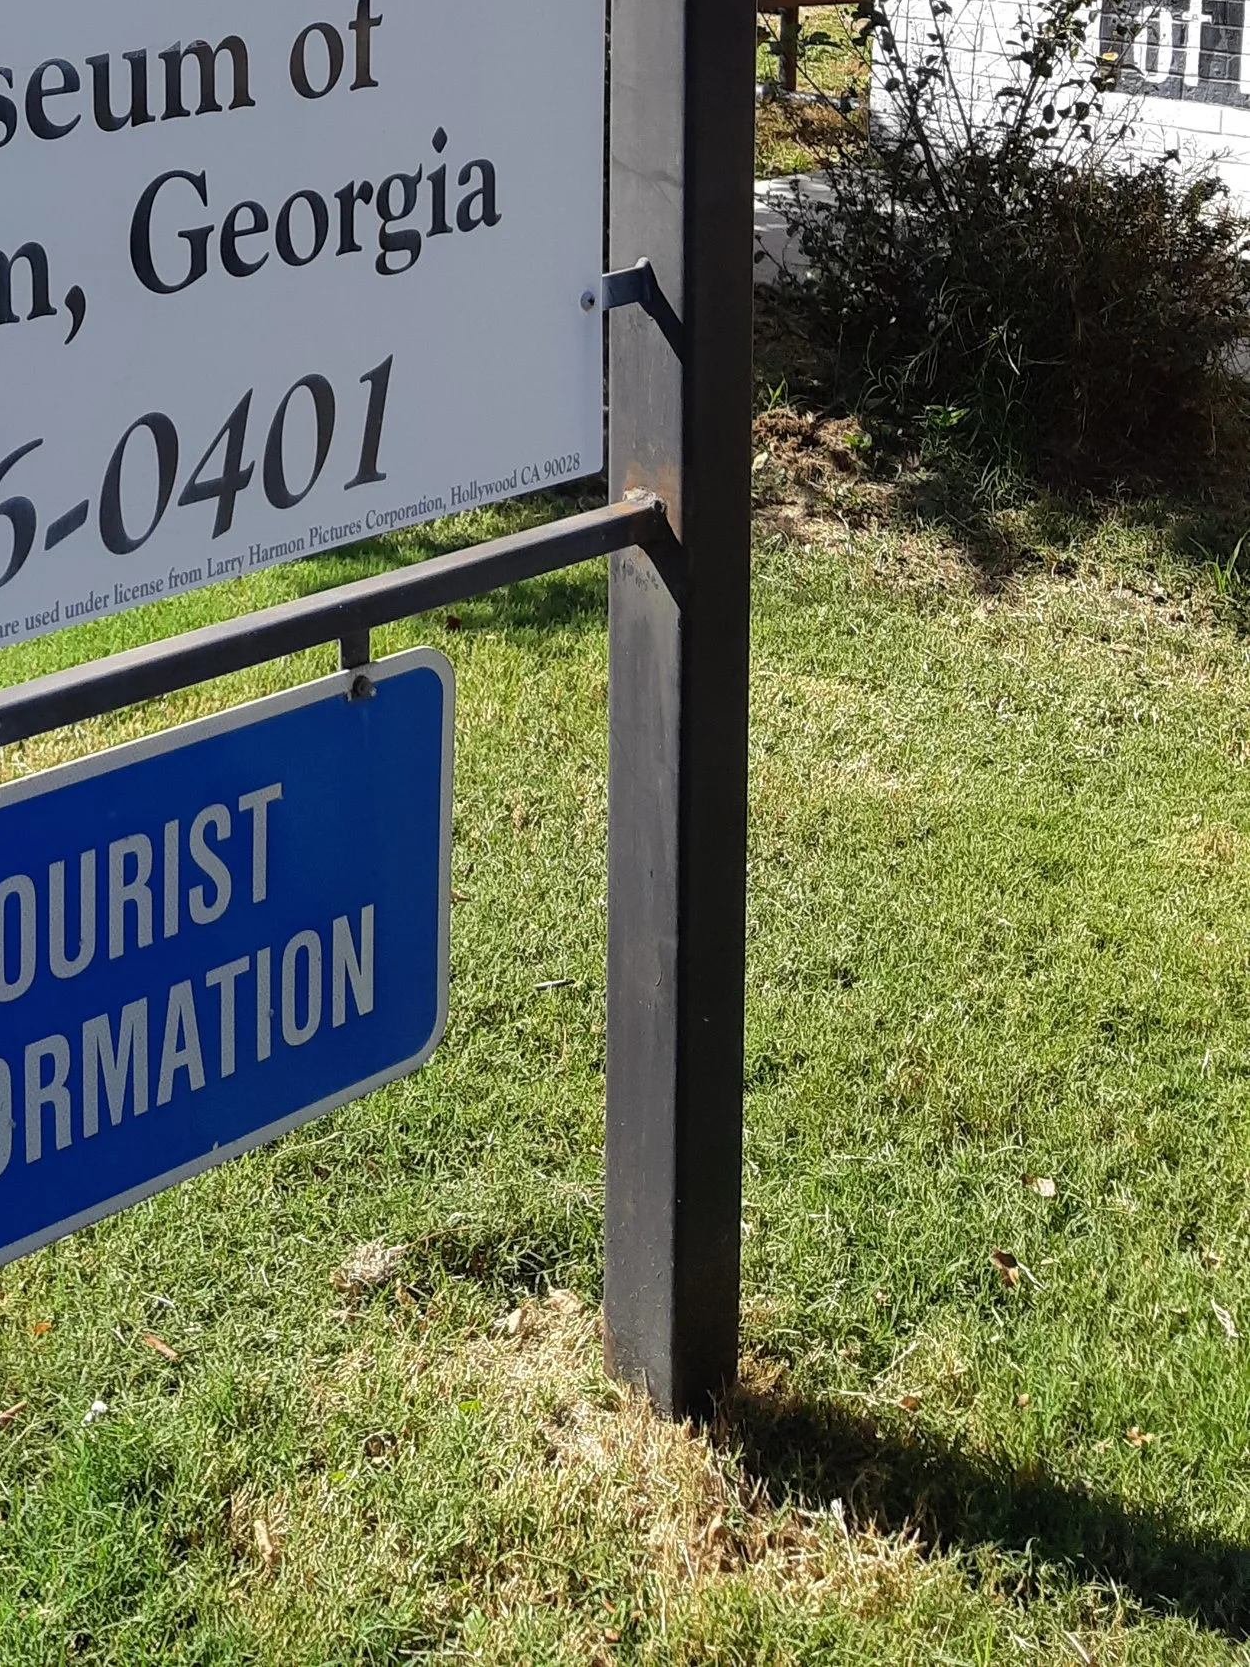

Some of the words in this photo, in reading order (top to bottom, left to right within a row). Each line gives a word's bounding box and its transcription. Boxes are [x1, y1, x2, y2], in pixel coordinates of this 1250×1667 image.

[129, 126, 502, 295] Georgia
[25, 602, 60, 631] used
[65, 591, 109, 619] under
[114, 578, 163, 605] license
[168, 567, 202, 590] from
[206, 553, 245, 579] Larry
[248, 535, 306, 565] Harmon
[309, 519, 362, 548] Pictures
[365, 494, 447, 530] Corporation,
[450, 469, 517, 506] Hollywood
[521, 466, 541, 486] CA
[543, 452, 581, 479] 90028
